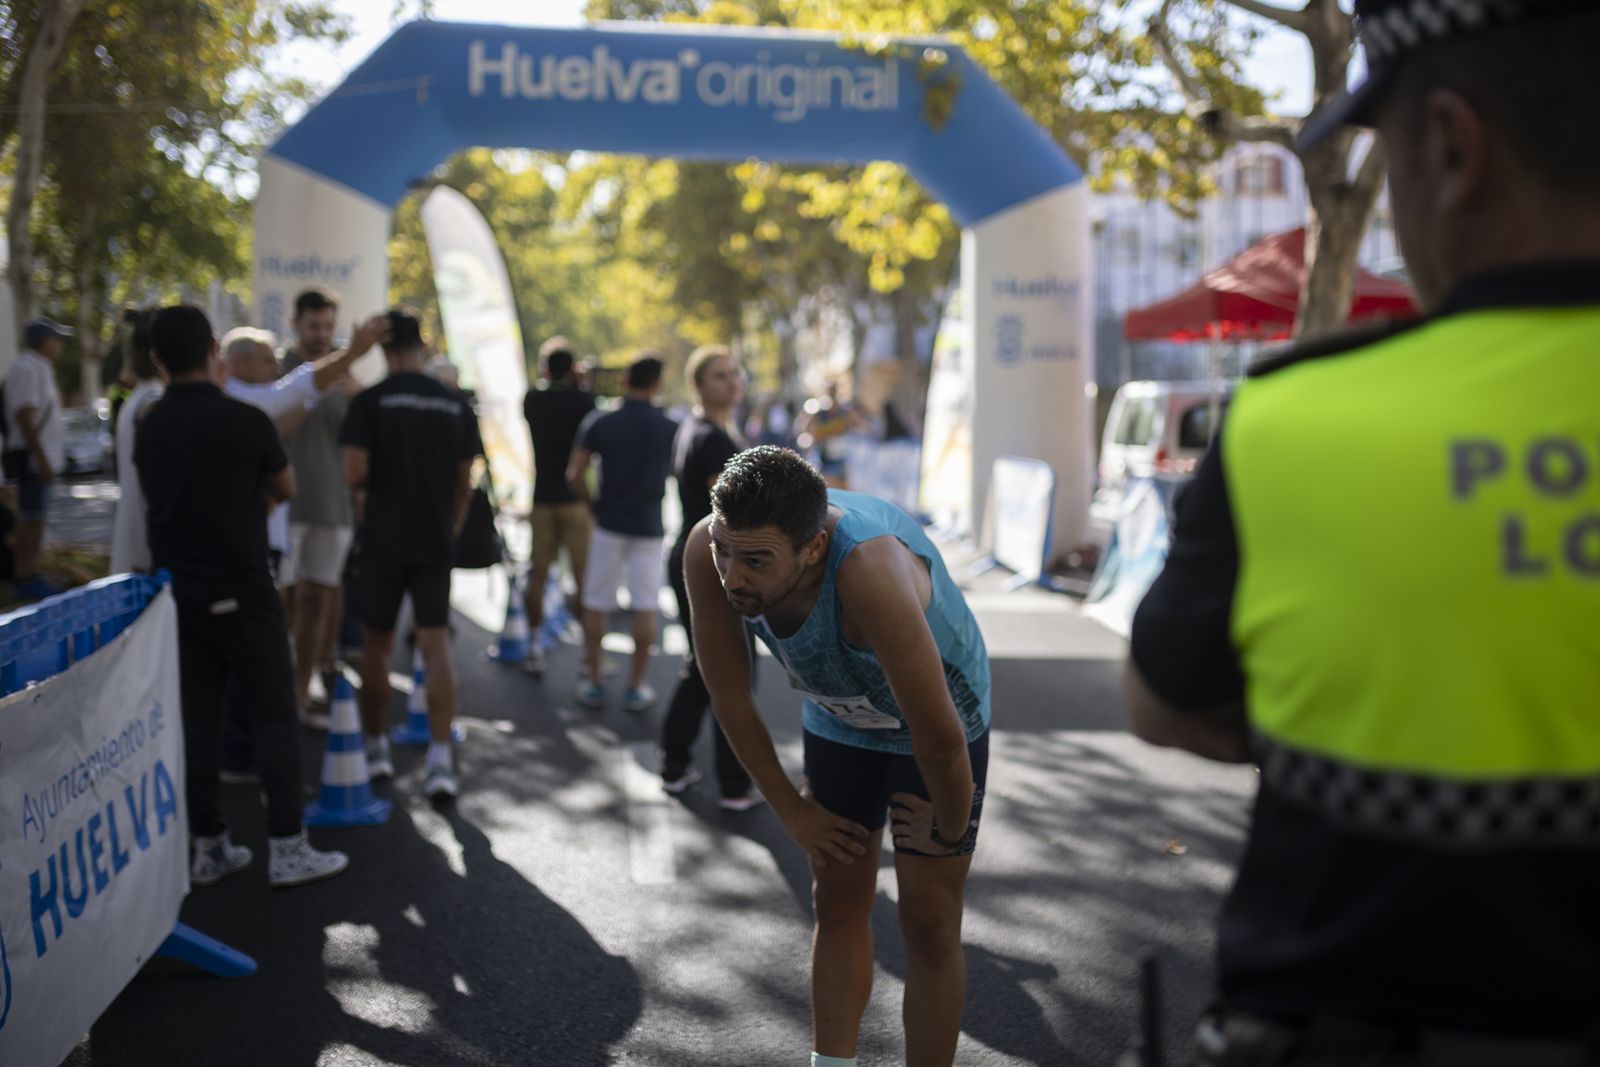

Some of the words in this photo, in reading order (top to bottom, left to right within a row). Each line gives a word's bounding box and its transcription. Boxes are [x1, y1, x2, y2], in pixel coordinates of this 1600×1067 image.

[467, 39, 681, 101] Huelva
[696, 50, 899, 122] original
[23, 718, 146, 844] Ayuntamiento
[148, 699, 166, 740] de
[28, 757, 178, 959] HUELVA
